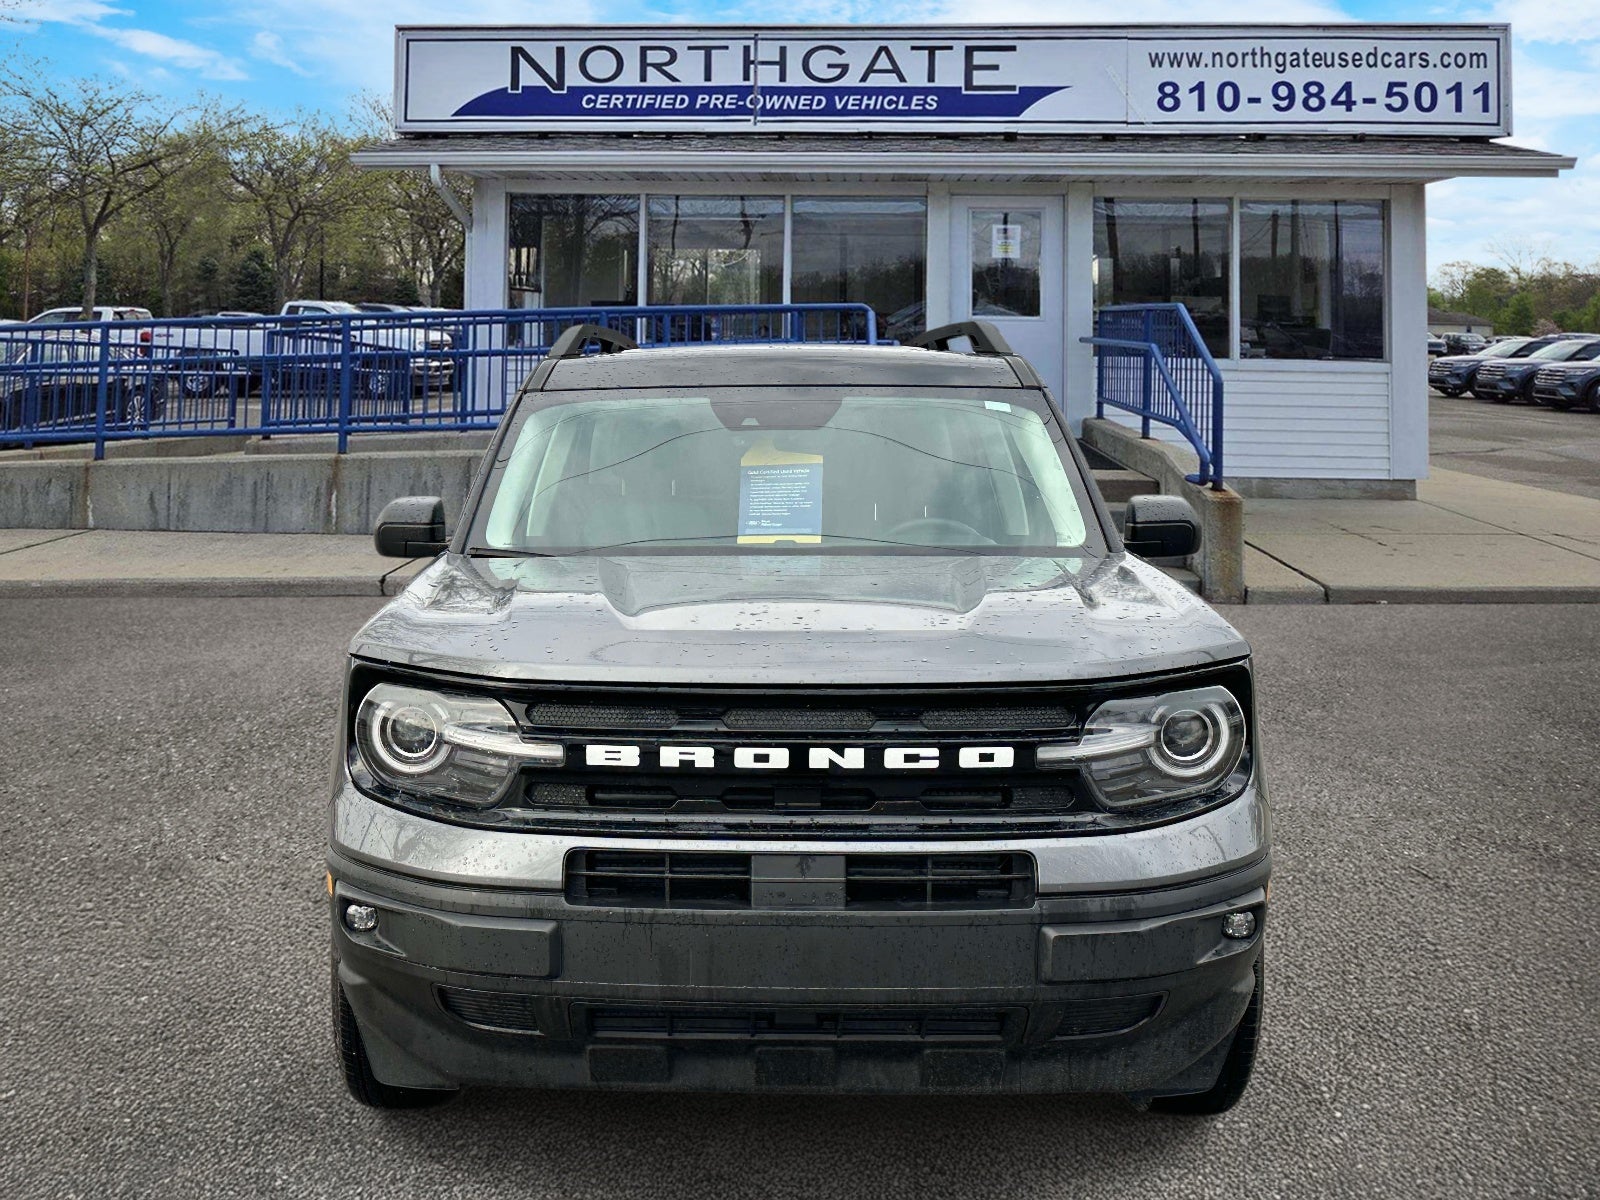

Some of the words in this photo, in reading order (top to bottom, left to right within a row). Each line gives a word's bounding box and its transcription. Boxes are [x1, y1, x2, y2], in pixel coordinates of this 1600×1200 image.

[509, 45, 1018, 93] NORTHGATE
[1148, 46, 1488, 74] www.northgateusedcars.com
[581, 94, 690, 109] CERTIFIED
[695, 94, 827, 110] PRE-OWNED
[834, 95, 939, 110] VEHICLES
[1156, 80, 1491, 113] 810-984-5011
[585, 745, 1015, 769] BRONCO
